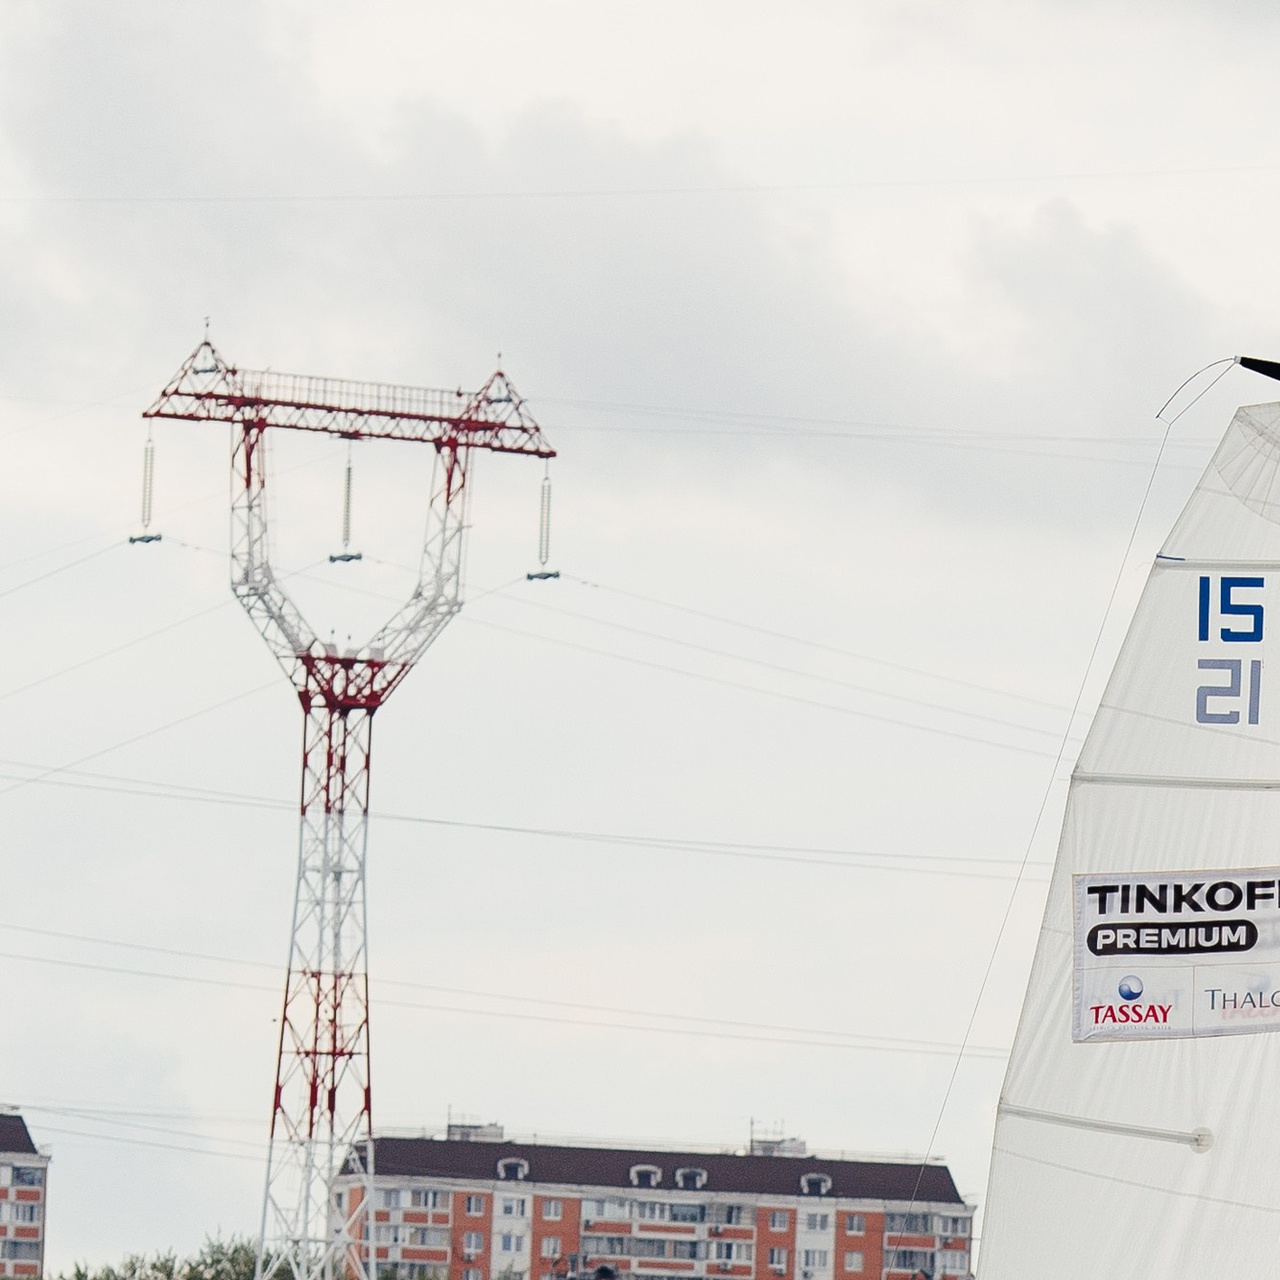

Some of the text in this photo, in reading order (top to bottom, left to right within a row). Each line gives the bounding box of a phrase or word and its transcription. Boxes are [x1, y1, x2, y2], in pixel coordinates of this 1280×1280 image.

[1198, 576, 1264, 642] 15
[1096, 925, 1247, 950] PREMIUM
[1090, 1004, 1172, 1024] TASSAY
